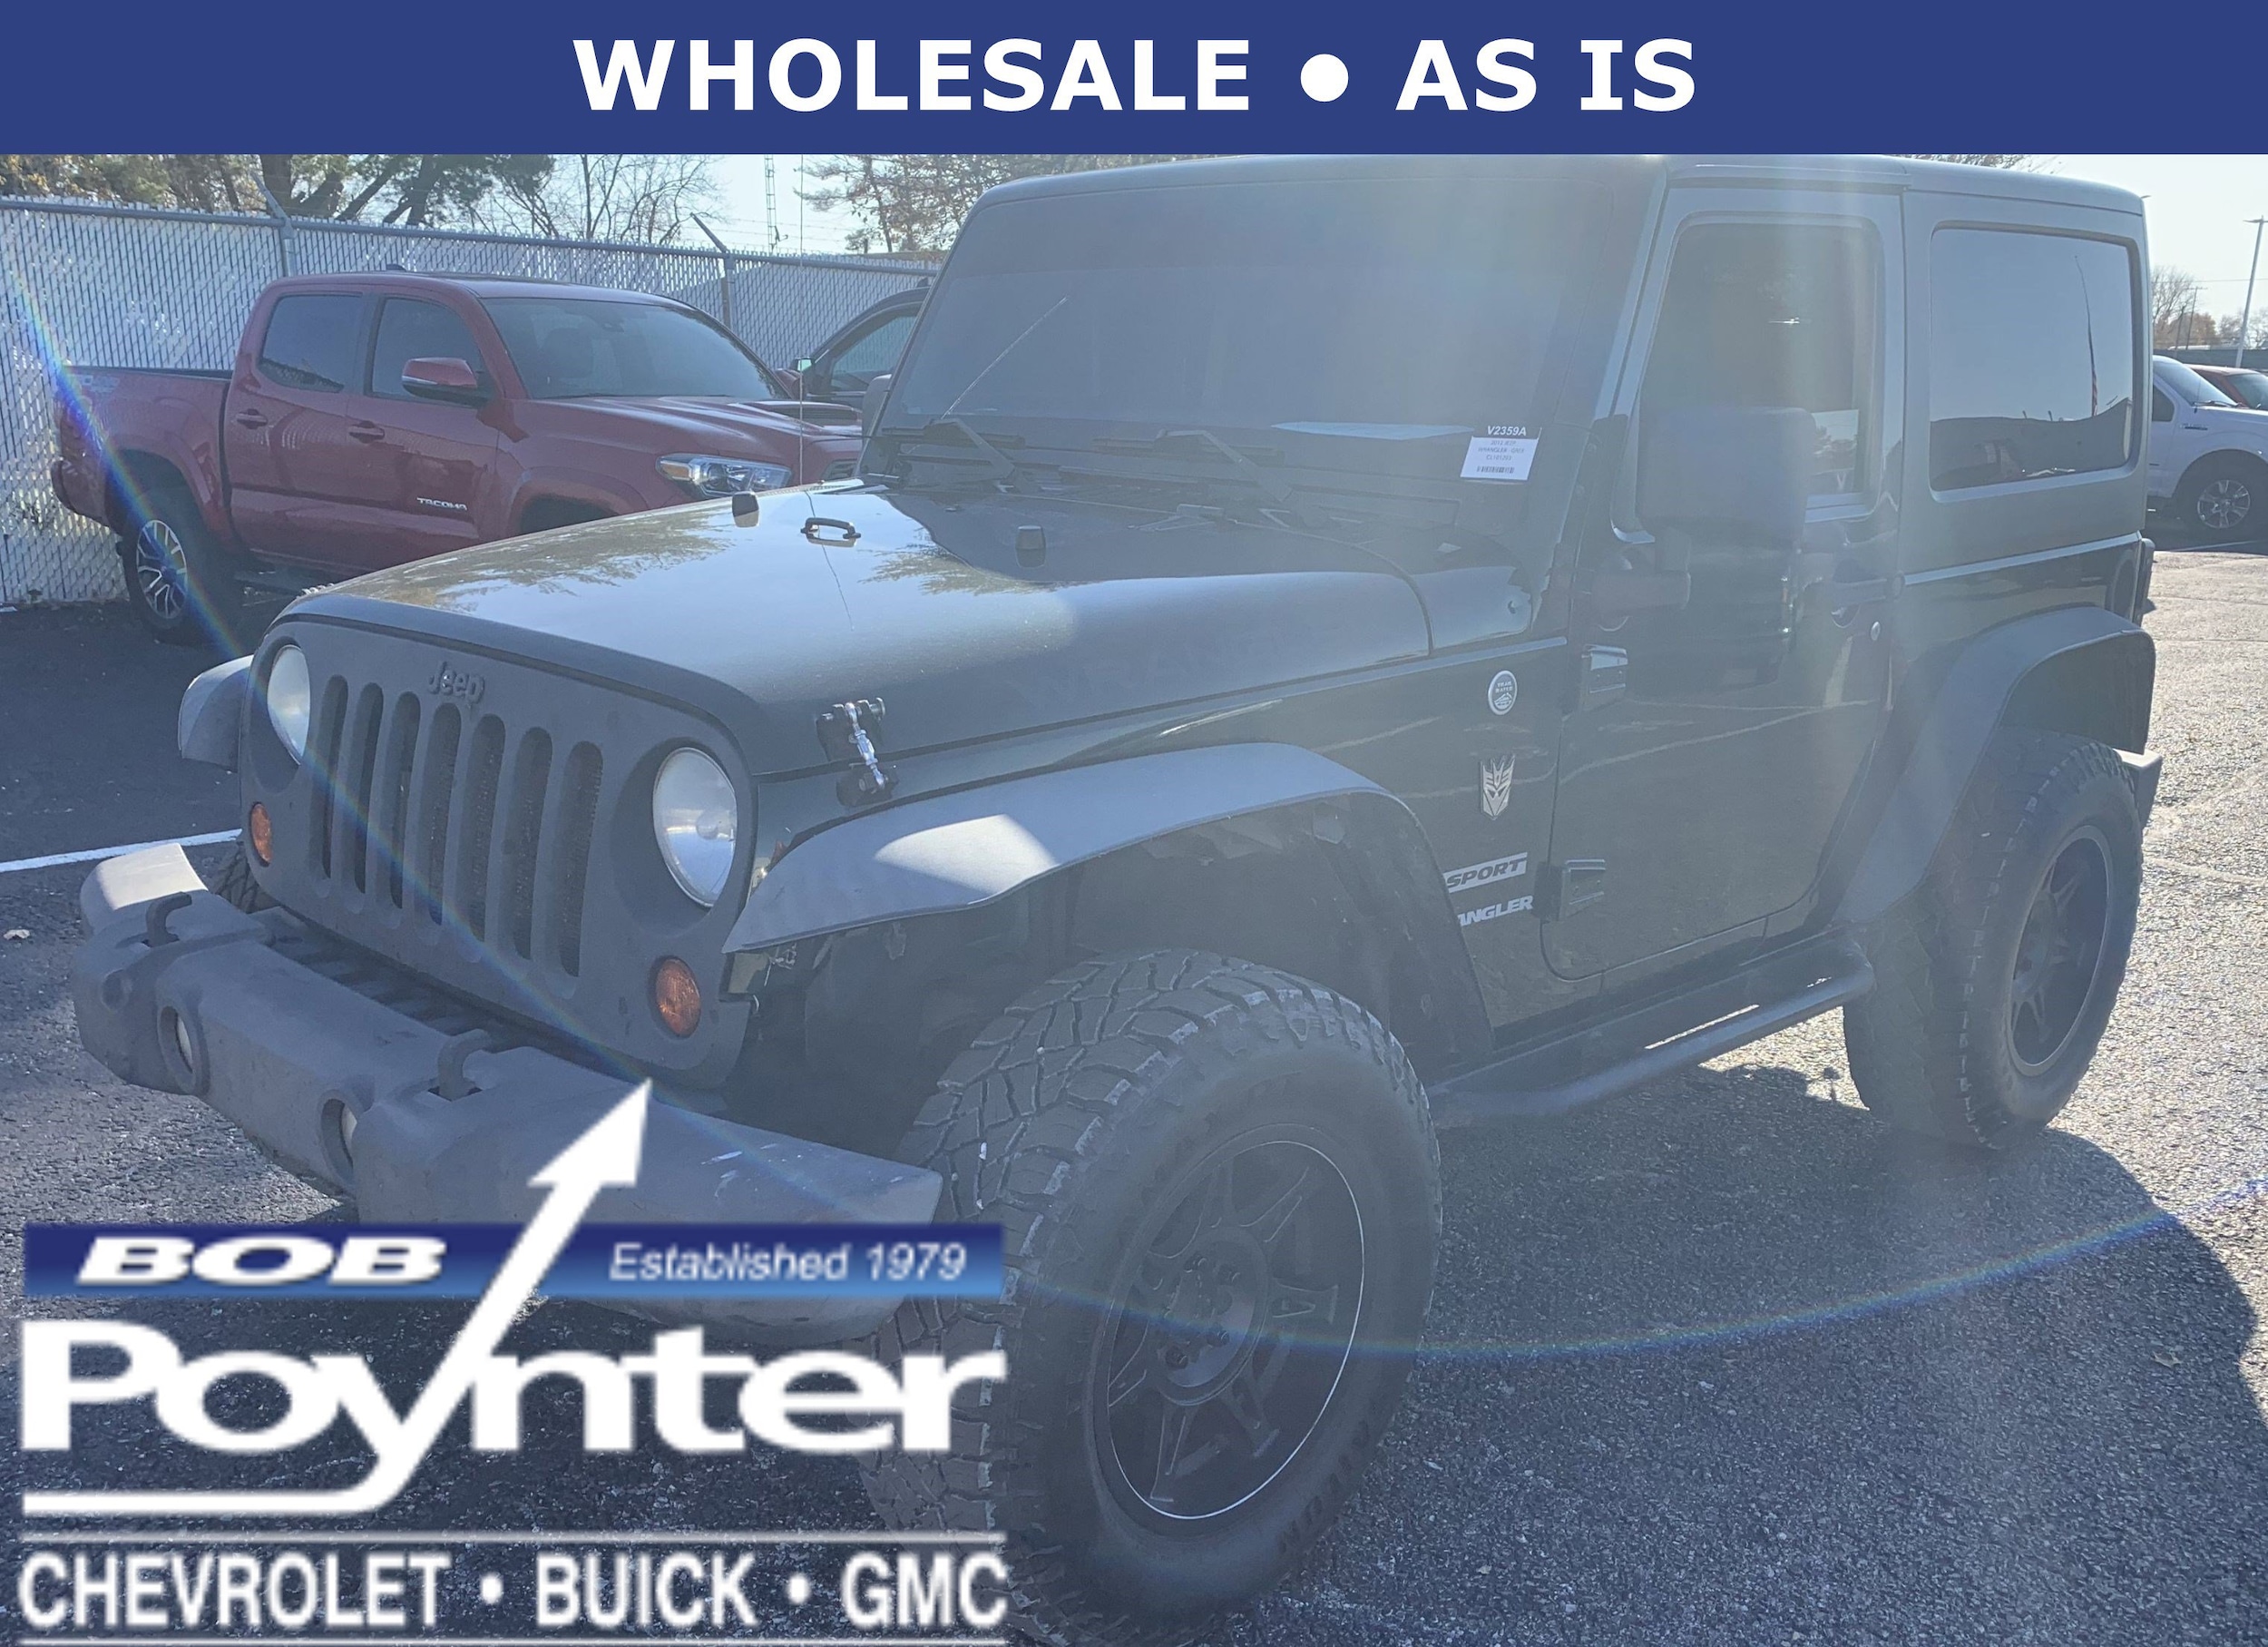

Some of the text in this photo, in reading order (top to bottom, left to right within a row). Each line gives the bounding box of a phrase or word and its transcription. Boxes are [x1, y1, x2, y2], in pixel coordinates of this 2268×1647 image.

[1487, 426, 1527, 436] V2359A
[416, 497, 468, 510] TACOMA
[428, 661, 486, 704] Jeep
[1446, 858, 1527, 887] SPORT
